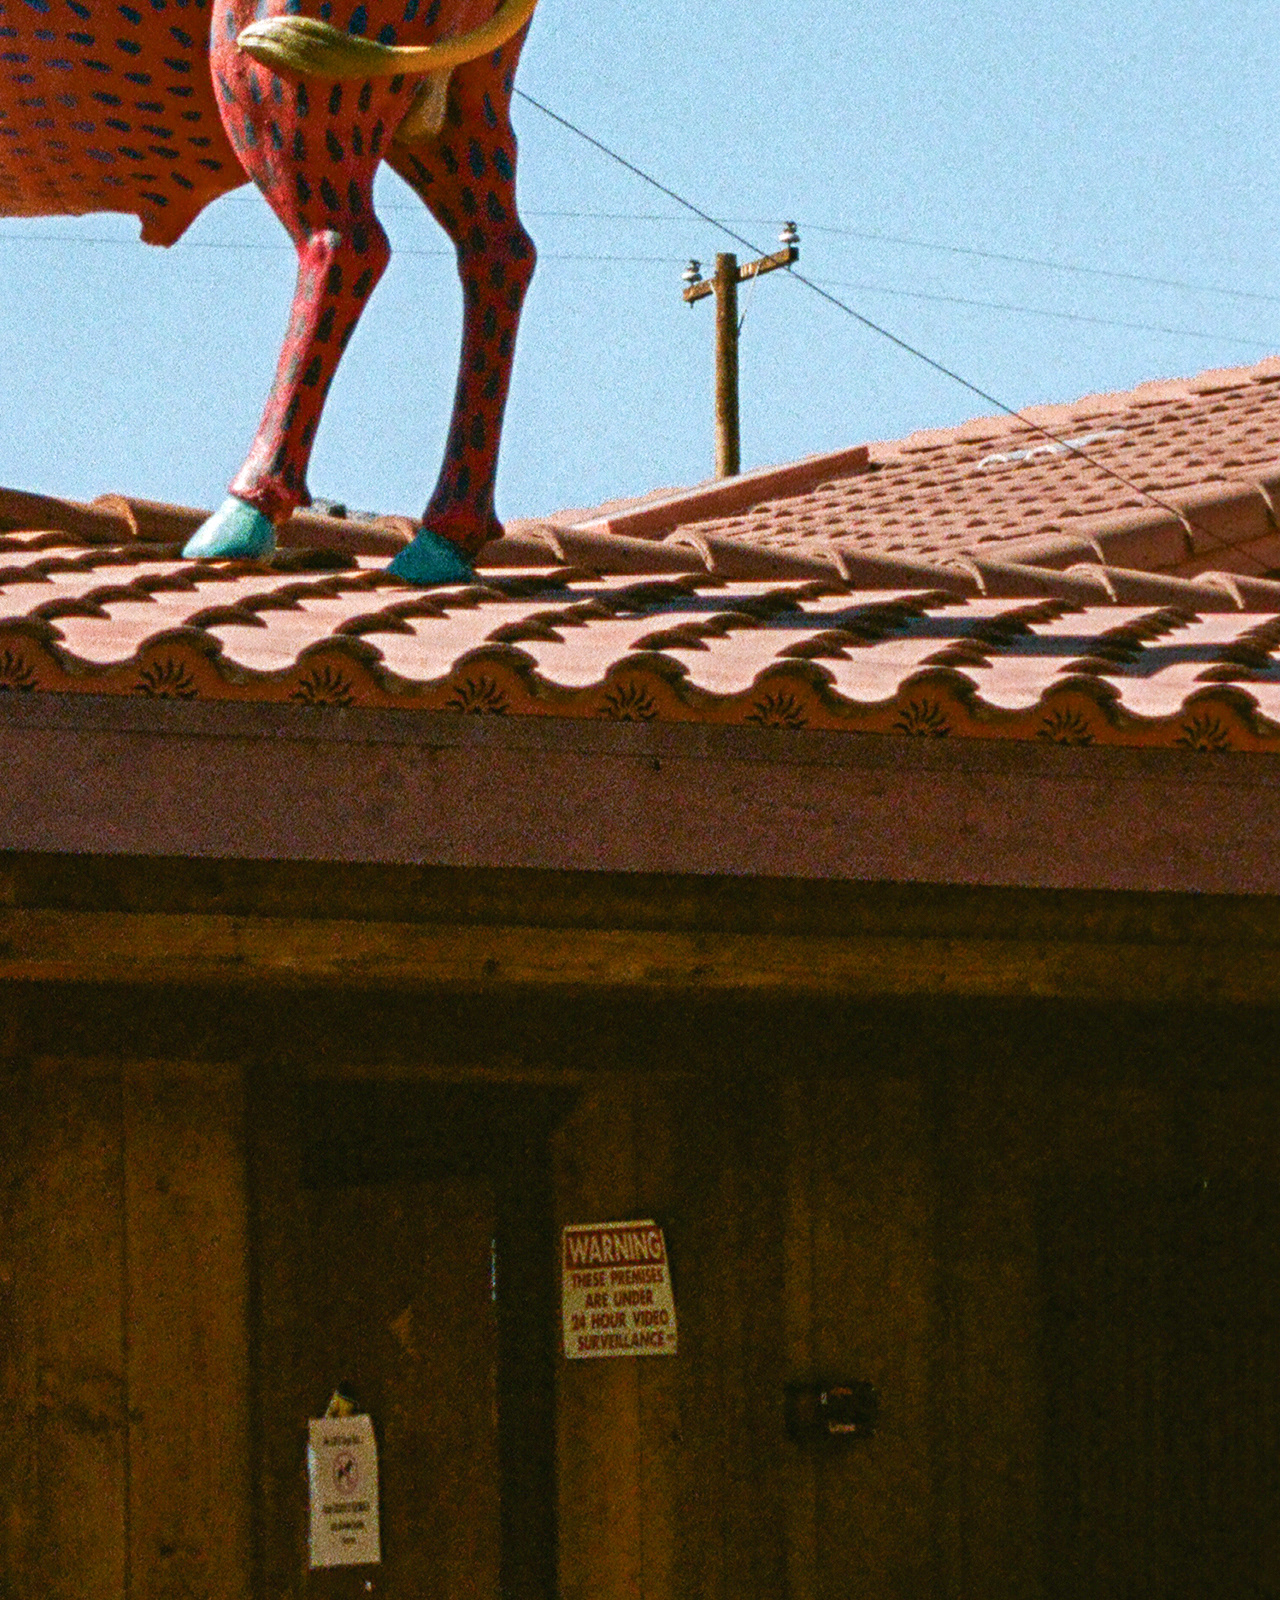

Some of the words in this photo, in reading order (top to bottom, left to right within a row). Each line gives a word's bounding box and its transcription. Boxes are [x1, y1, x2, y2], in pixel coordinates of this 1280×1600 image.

[567, 1230, 662, 1265] WARNING
[571, 1272, 606, 1288] THESE
[609, 1267, 665, 1285] PREMISES
[584, 1292, 609, 1309] ARE
[613, 1289, 653, 1307] UNDER
[571, 1313, 587, 1331] 24
[591, 1312, 627, 1329] HOUR
[632, 1309, 669, 1326] VIDEO
[577, 1331, 665, 1351] SURVEILLANCE
